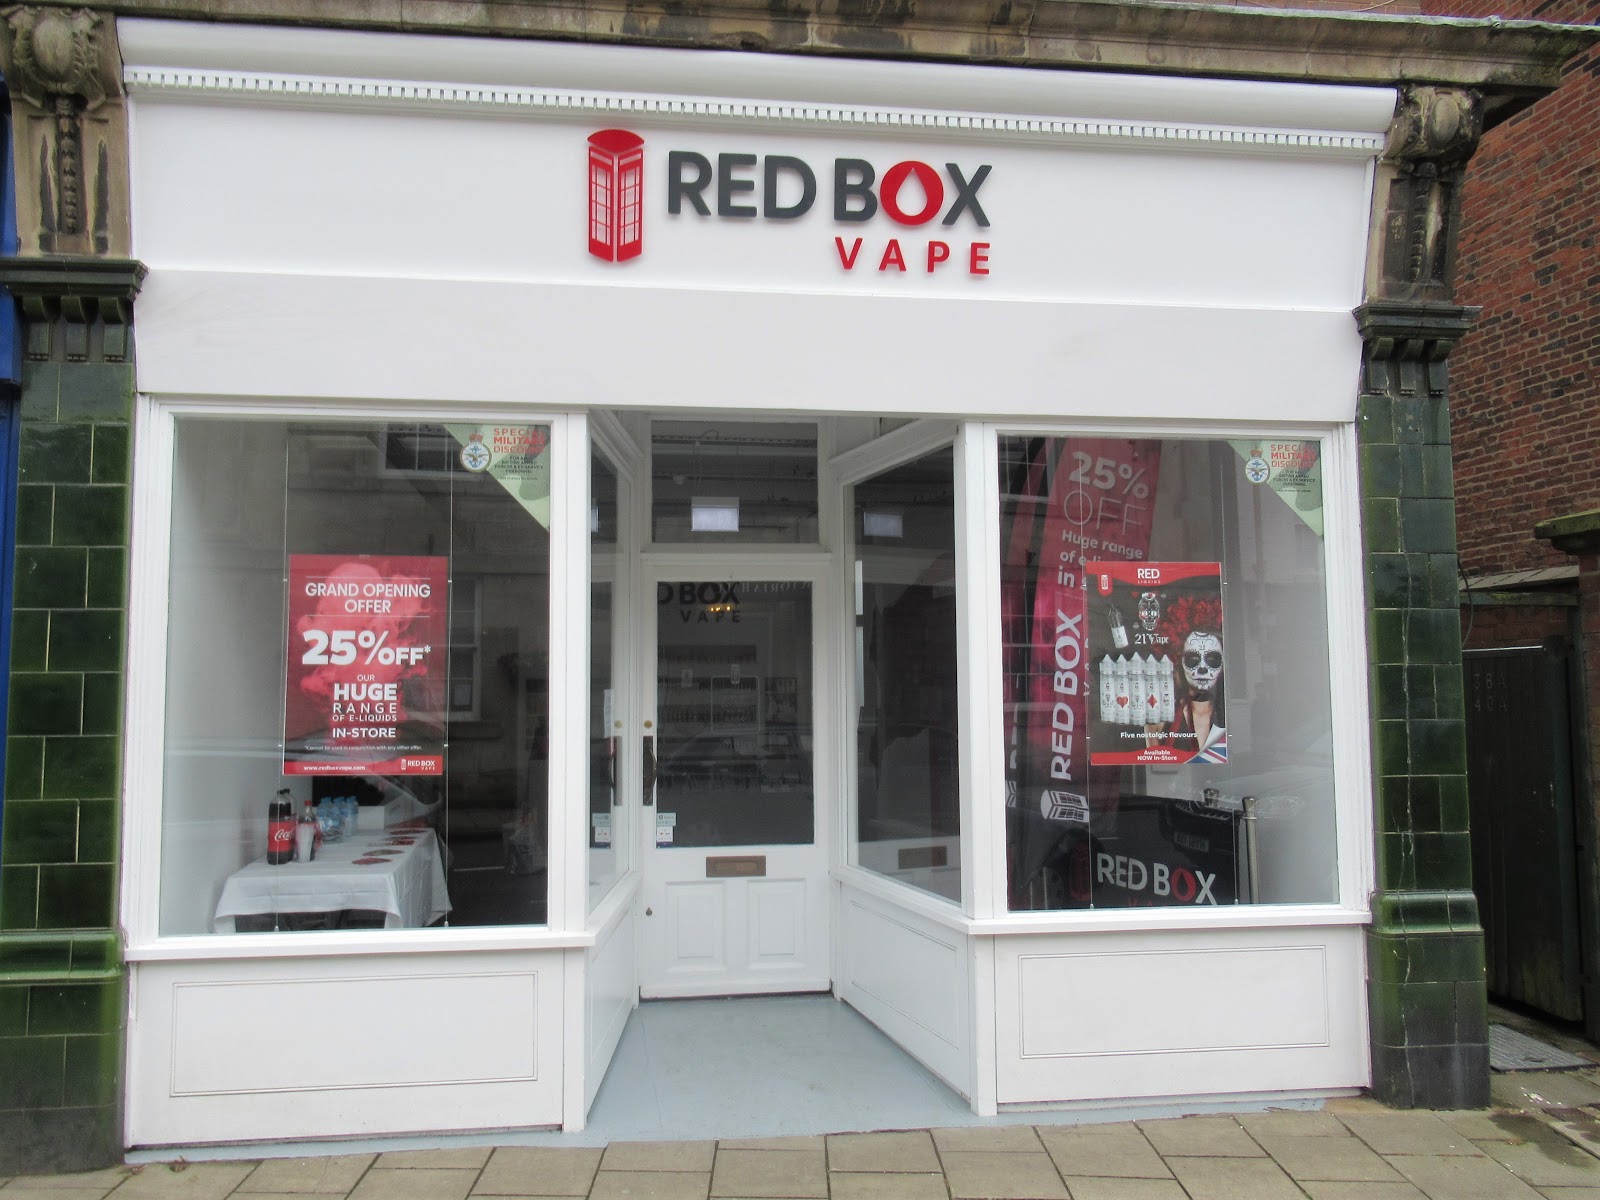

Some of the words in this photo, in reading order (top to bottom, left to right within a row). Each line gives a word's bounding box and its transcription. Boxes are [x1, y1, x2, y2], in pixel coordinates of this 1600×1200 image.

[667, 150, 817, 219] RED
[833, 157, 992, 228] BOX
[834, 236, 991, 275] VAPE
[1069, 451, 1149, 499] 25%
[1064, 490, 1147, 535] OFF
[1061, 529, 1099, 549] Huge
[1102, 539, 1143, 560] range
[1060, 551, 1076, 563] of
[1057, 565, 1075, 588] in
[1137, 568, 1160, 579] RED
[305, 582, 359, 597] GRAND
[363, 583, 431, 598] OPENING
[679, 582, 740, 605] BOX
[344, 599, 392, 613] OFFER
[680, 610, 741, 623] VAPE
[1134, 633, 1147, 645] 21
[1053, 608, 1083, 696] BOX
[357, 674, 375, 682] OUR
[334, 683, 398, 701] HUGE
[333, 703, 397, 714] RANGE
[332, 714, 345, 722] OF
[349, 714, 397, 722] E-LIQUIDS
[332, 727, 396, 738] IN-STORE
[1050, 701, 1074, 781] RED
[303, 764, 366, 772] www.redboxvape.com
[1097, 852, 1147, 891] RED
[1153, 862, 1218, 905] BOX
